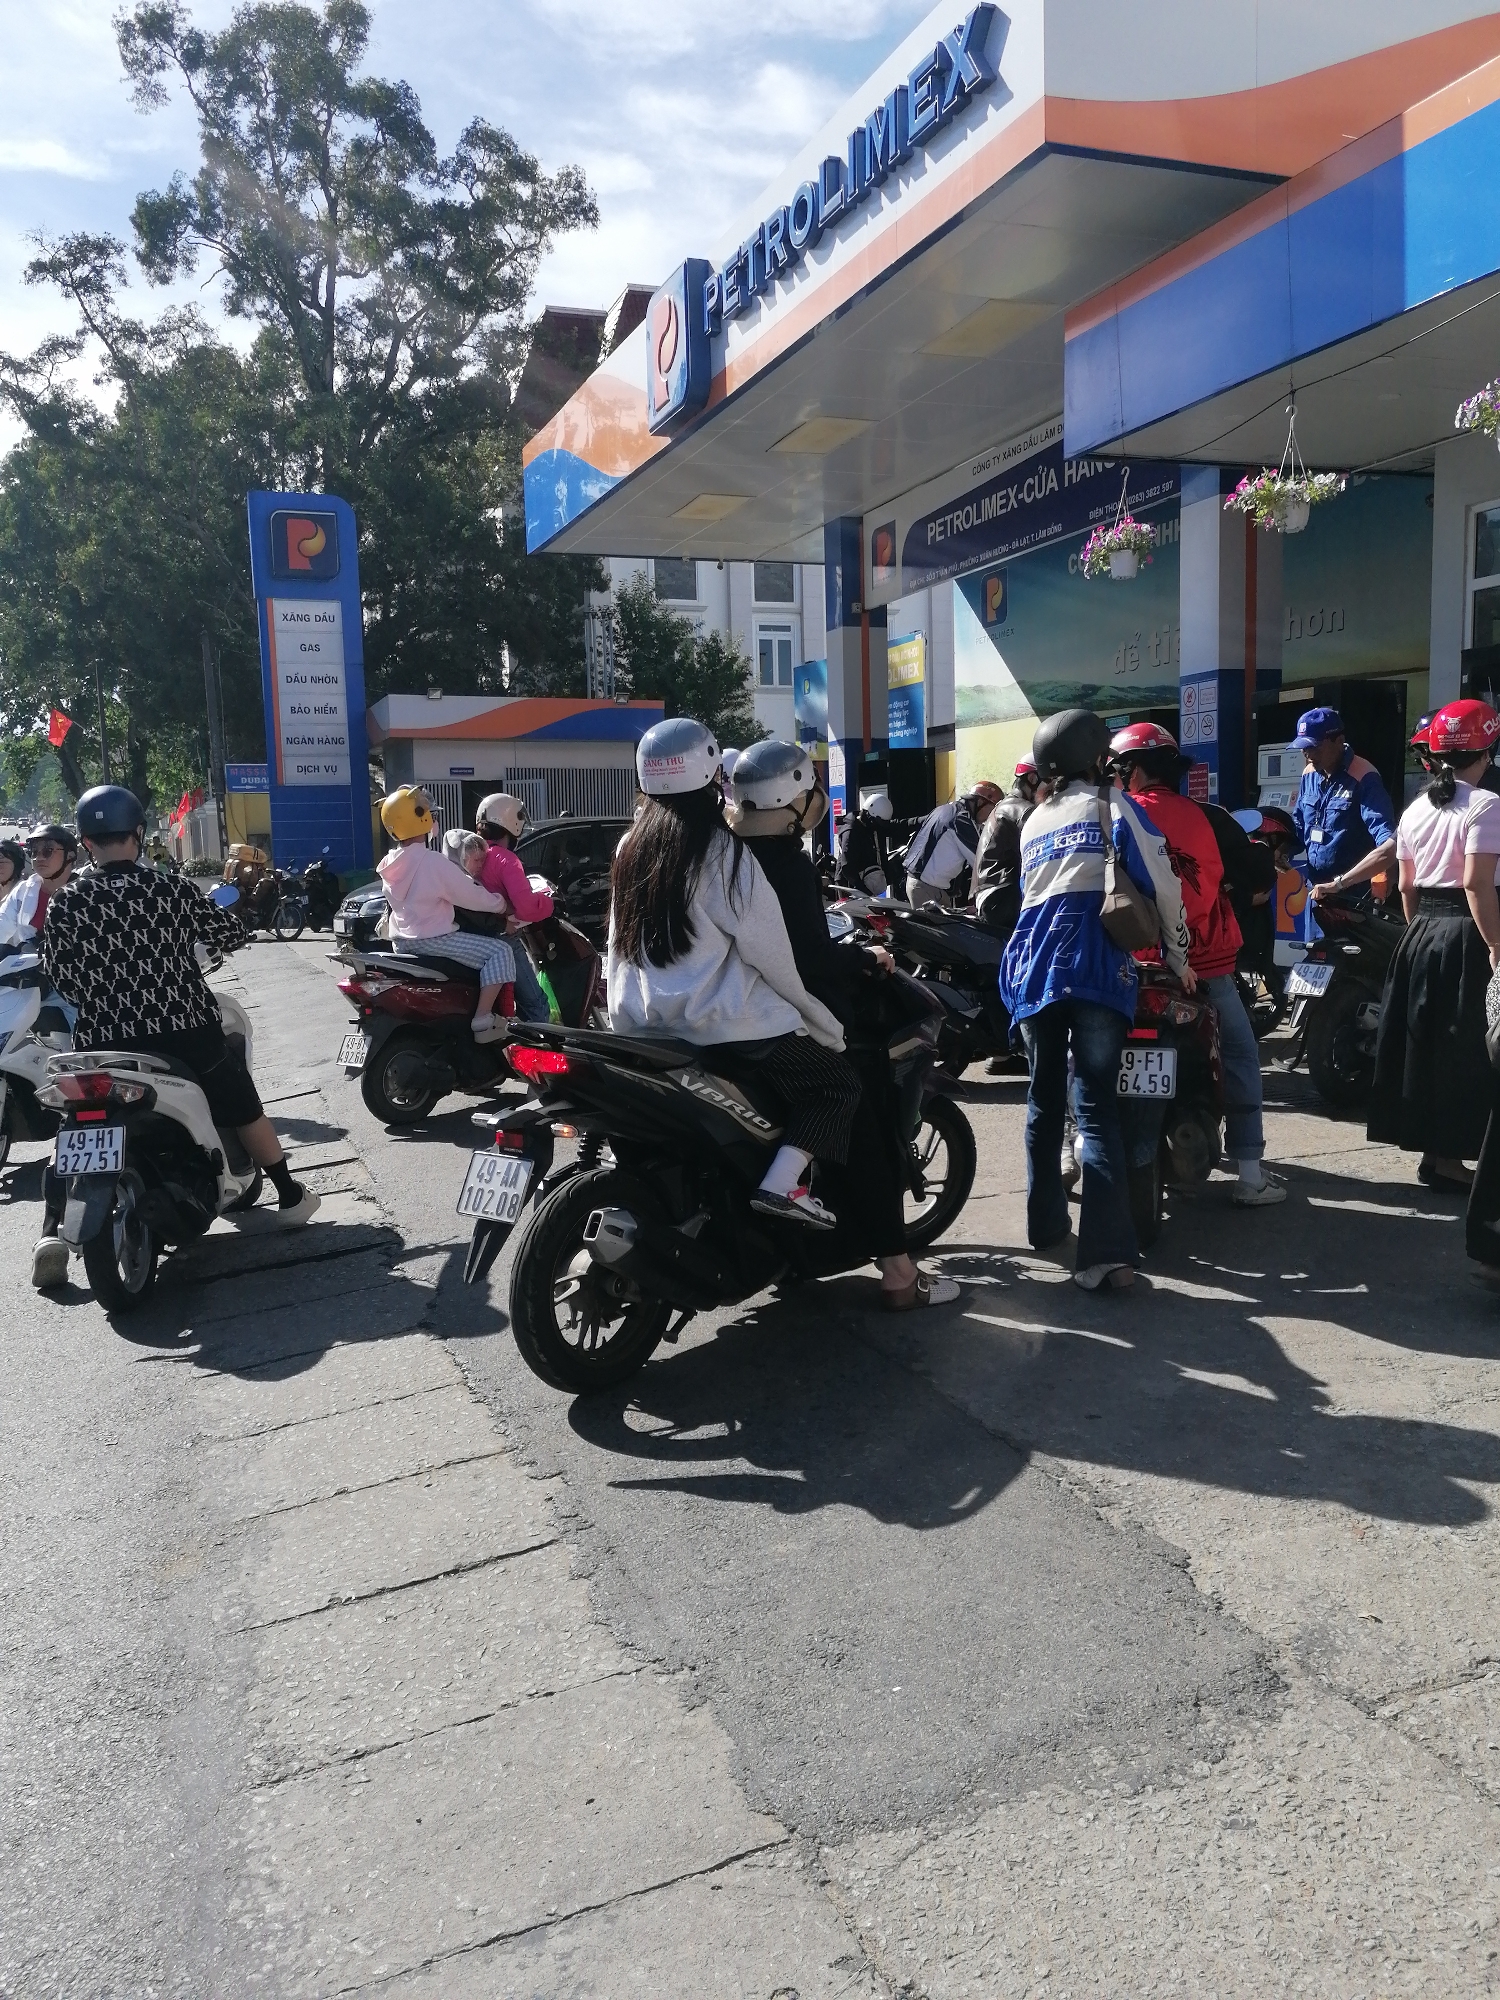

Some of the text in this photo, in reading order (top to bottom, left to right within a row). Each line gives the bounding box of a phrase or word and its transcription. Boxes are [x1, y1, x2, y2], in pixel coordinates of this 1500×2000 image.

[703, 2, 1010, 337] PETROLIMEX
[972, 460, 991, 476] CÔNG
[992, 455, 1001, 466] TY
[1002, 444, 1022, 461] XĂNG
[1023, 433, 1039, 451] DẦU
[1040, 427, 1056, 442] LÂM
[281, 610, 336, 624] XĂNG DẦU
[299, 642, 321, 653] GAS
[285, 671, 339, 685] DẦU NHỜN
[290, 701, 338, 715] BẢO HIỂM
[285, 733, 346, 746] NGÂN HÀNG
[296, 763, 338, 777] DỊCH VỤ
[1121, 1051, 1164, 1072] 9-F1
[679, 1073, 772, 1131] VARIO
[66, 1128, 114, 1151] 49-H1
[58, 1150, 120, 1174] 327.51
[475, 1156, 522, 1191] 49-AA
[465, 1184, 520, 1219] 102.08
